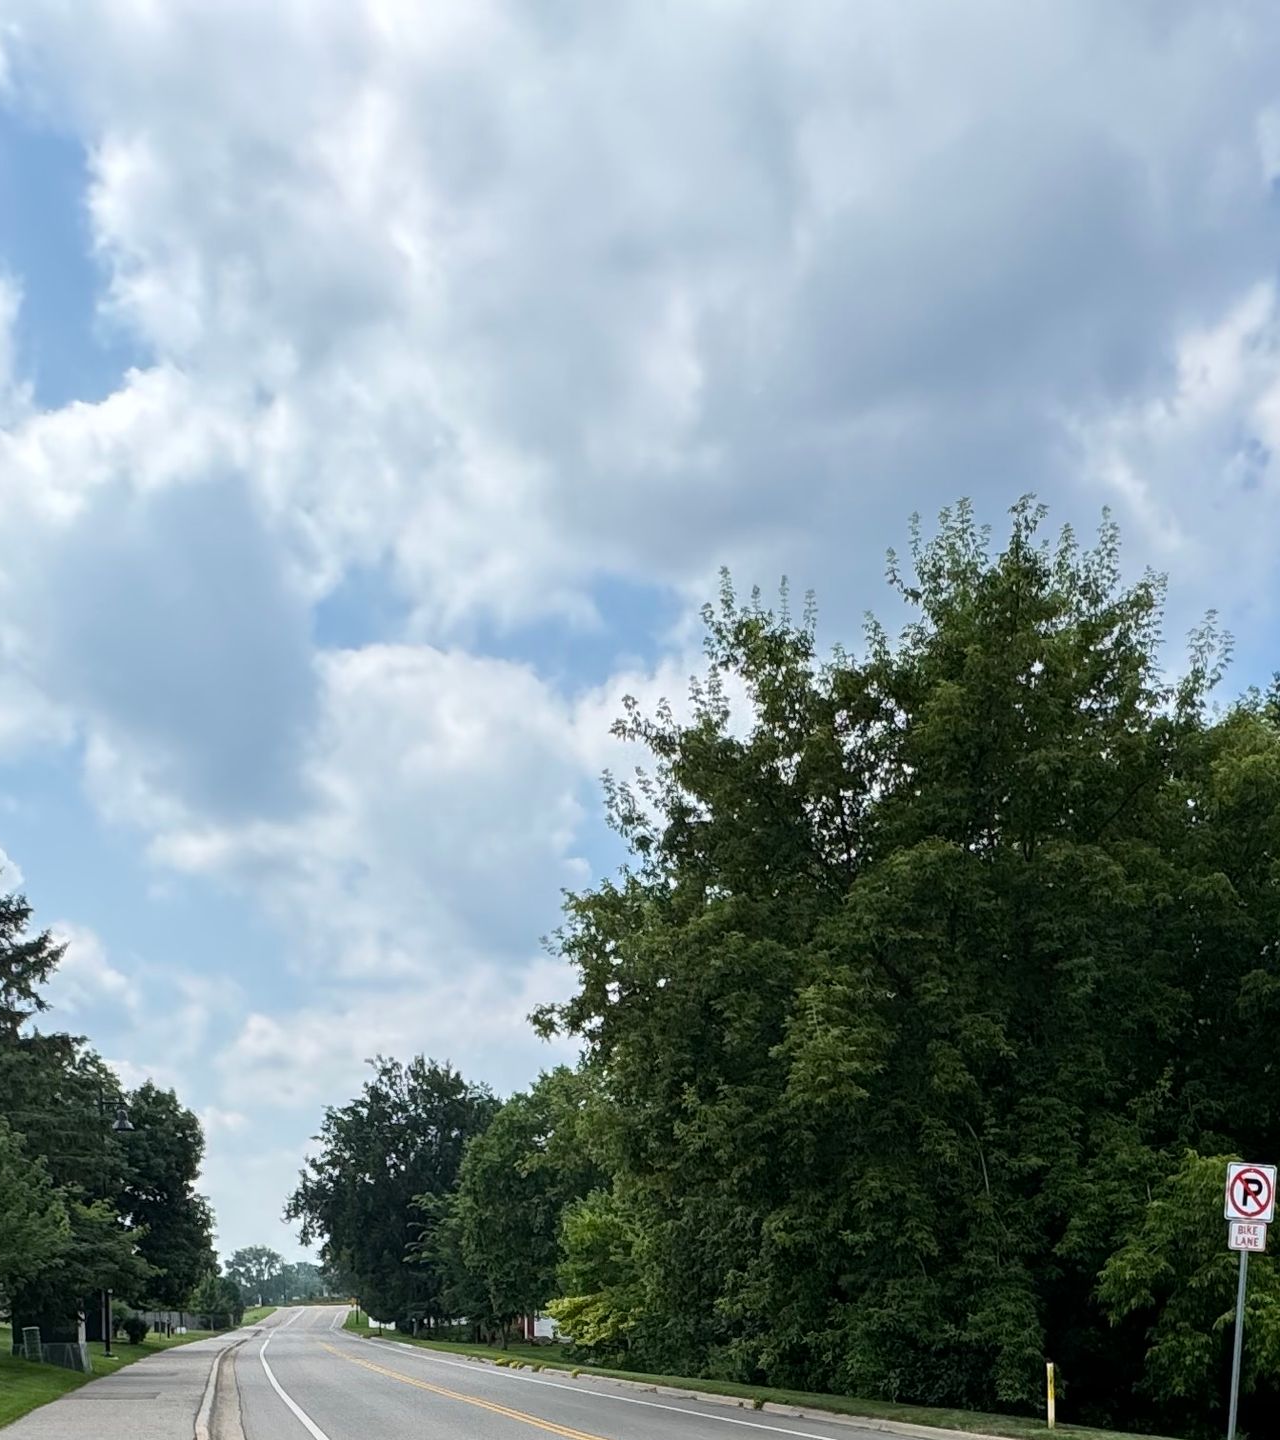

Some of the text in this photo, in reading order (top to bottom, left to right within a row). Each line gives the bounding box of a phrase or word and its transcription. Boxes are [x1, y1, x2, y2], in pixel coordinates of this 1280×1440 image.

[1242, 1178, 1263, 1206] P
[1237, 1225, 1258, 1236] BIKE
[1235, 1235, 1259, 1247] LANE
